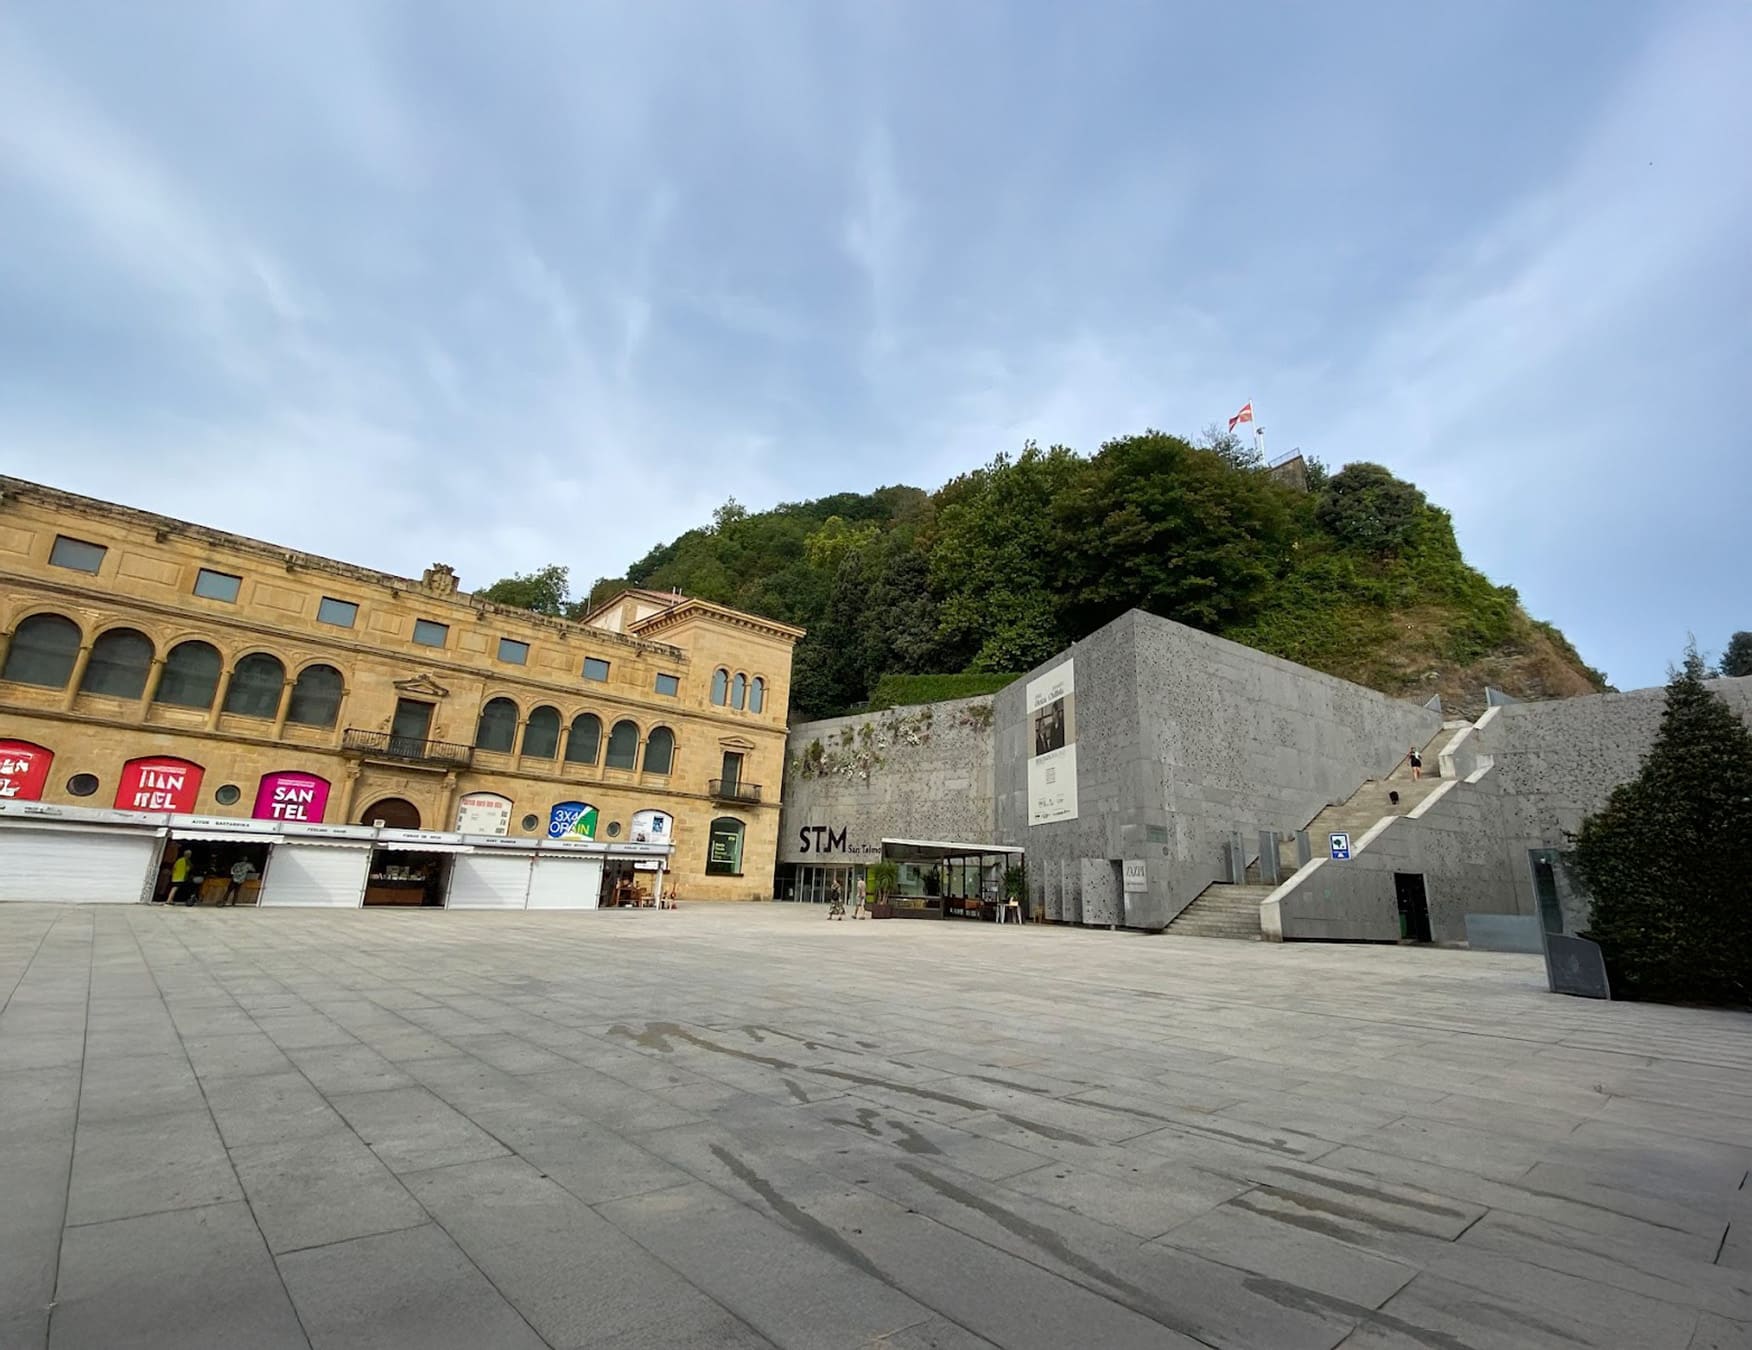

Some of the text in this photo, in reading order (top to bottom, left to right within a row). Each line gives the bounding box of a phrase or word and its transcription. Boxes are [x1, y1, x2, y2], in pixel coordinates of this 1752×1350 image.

[274, 787, 314, 803] SAN
[272, 803, 308, 820] TEL
[799, 826, 848, 853] STM
[848, 844, 860, 854] San
